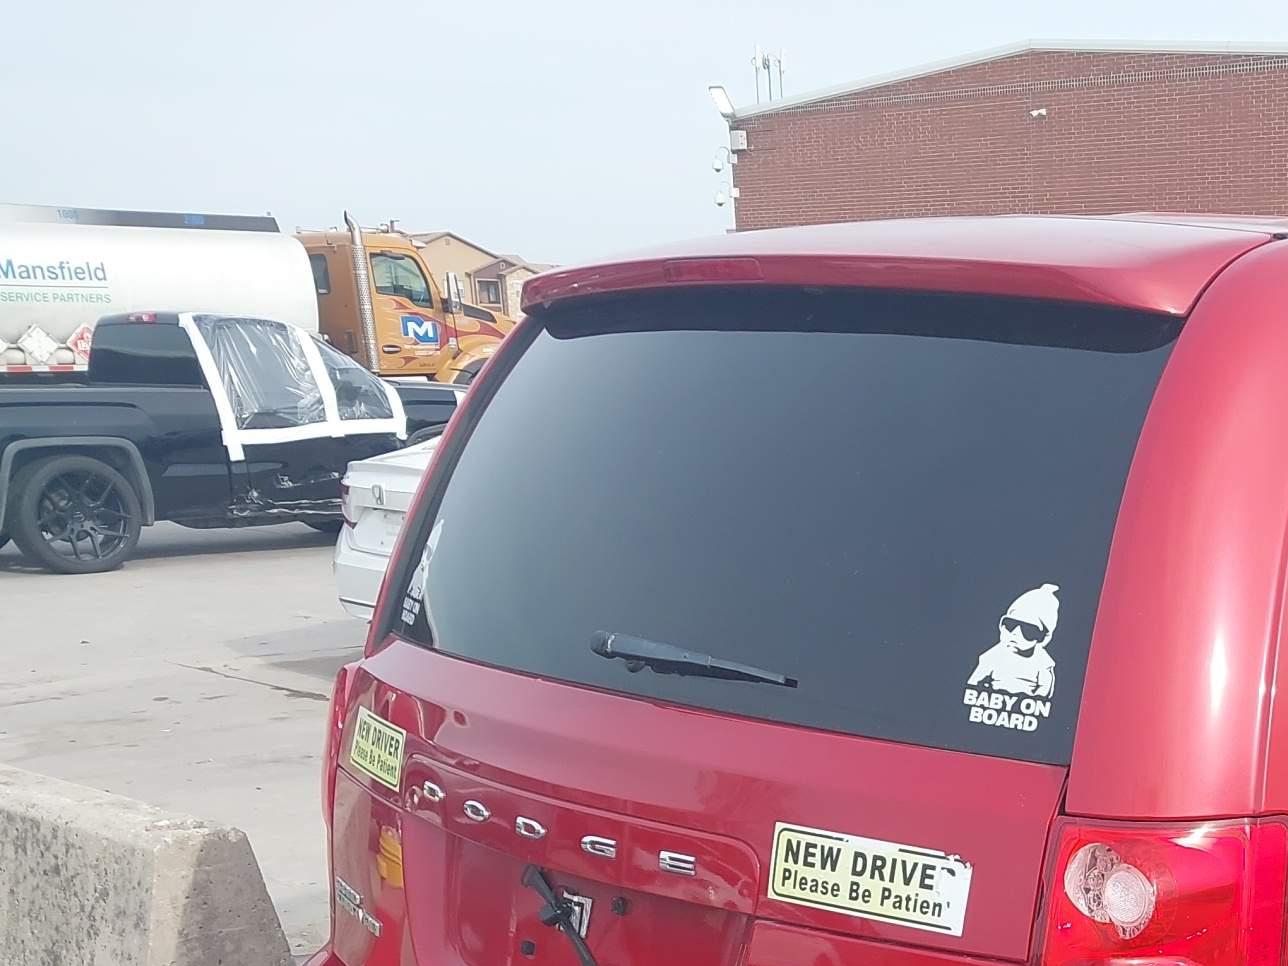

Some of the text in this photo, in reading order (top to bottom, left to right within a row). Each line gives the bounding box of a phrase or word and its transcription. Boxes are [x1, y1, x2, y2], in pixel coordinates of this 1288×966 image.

[0, 259, 107, 281] Mansfield
[0, 291, 112, 304] SERVICE PARTNERS
[963, 688, 1051, 718] BABY ON
[969, 706, 1038, 732] BOARD
[358, 719, 400, 760] NEW DRIVER
[368, 748, 376, 767] Be
[376, 753, 398, 780] Patient
[422, 780, 697, 877] DODGE
[783, 838, 842, 873] NEW
[781, 868, 841, 898] Please
[848, 881, 872, 904] Be
